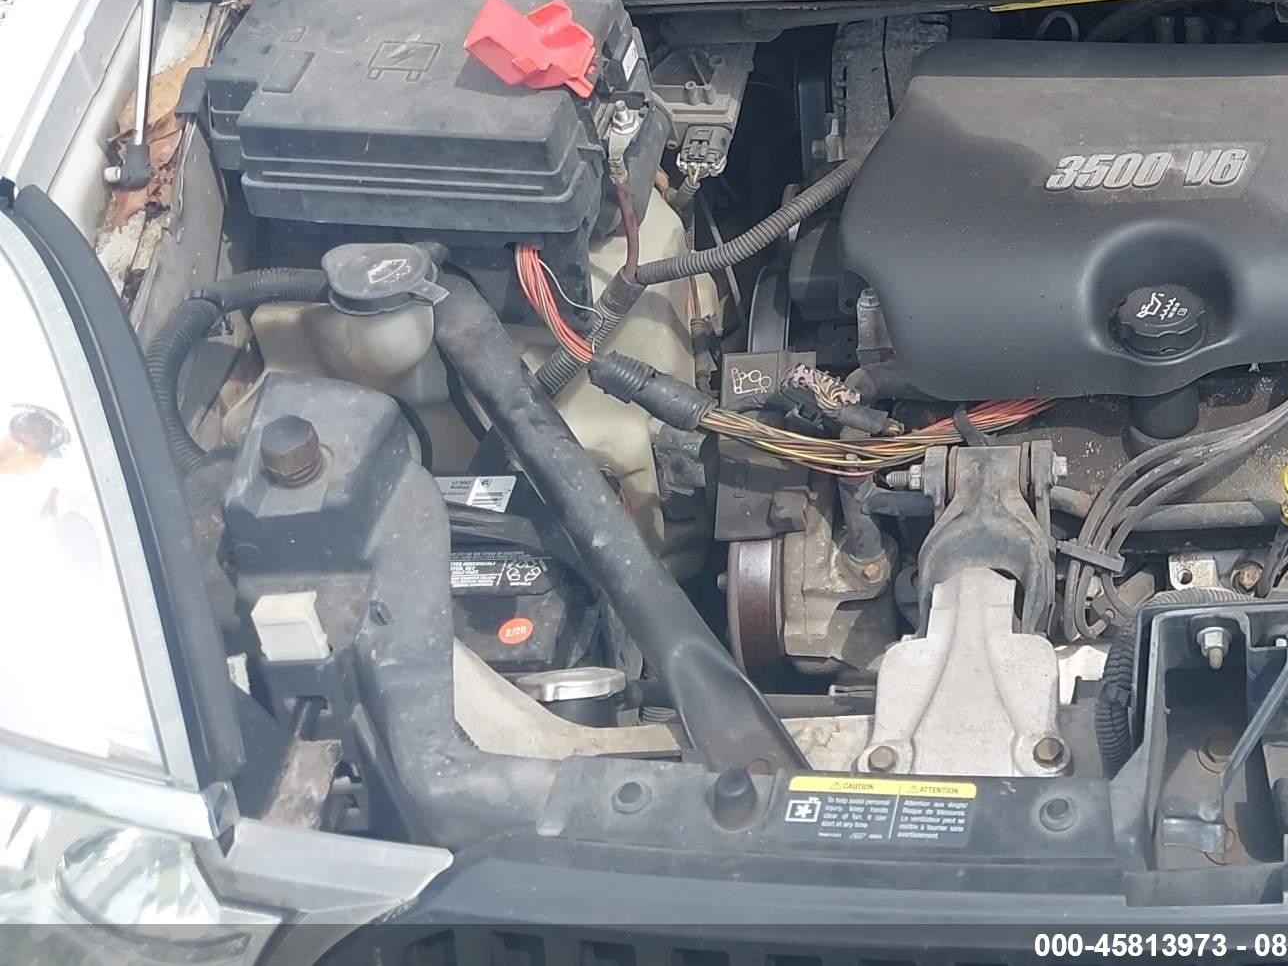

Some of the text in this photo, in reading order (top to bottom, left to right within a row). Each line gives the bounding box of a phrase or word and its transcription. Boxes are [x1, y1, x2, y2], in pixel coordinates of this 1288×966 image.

[1045, 149, 1249, 191] 3500 V6
[920, 786, 958, 794] ATTENTION
